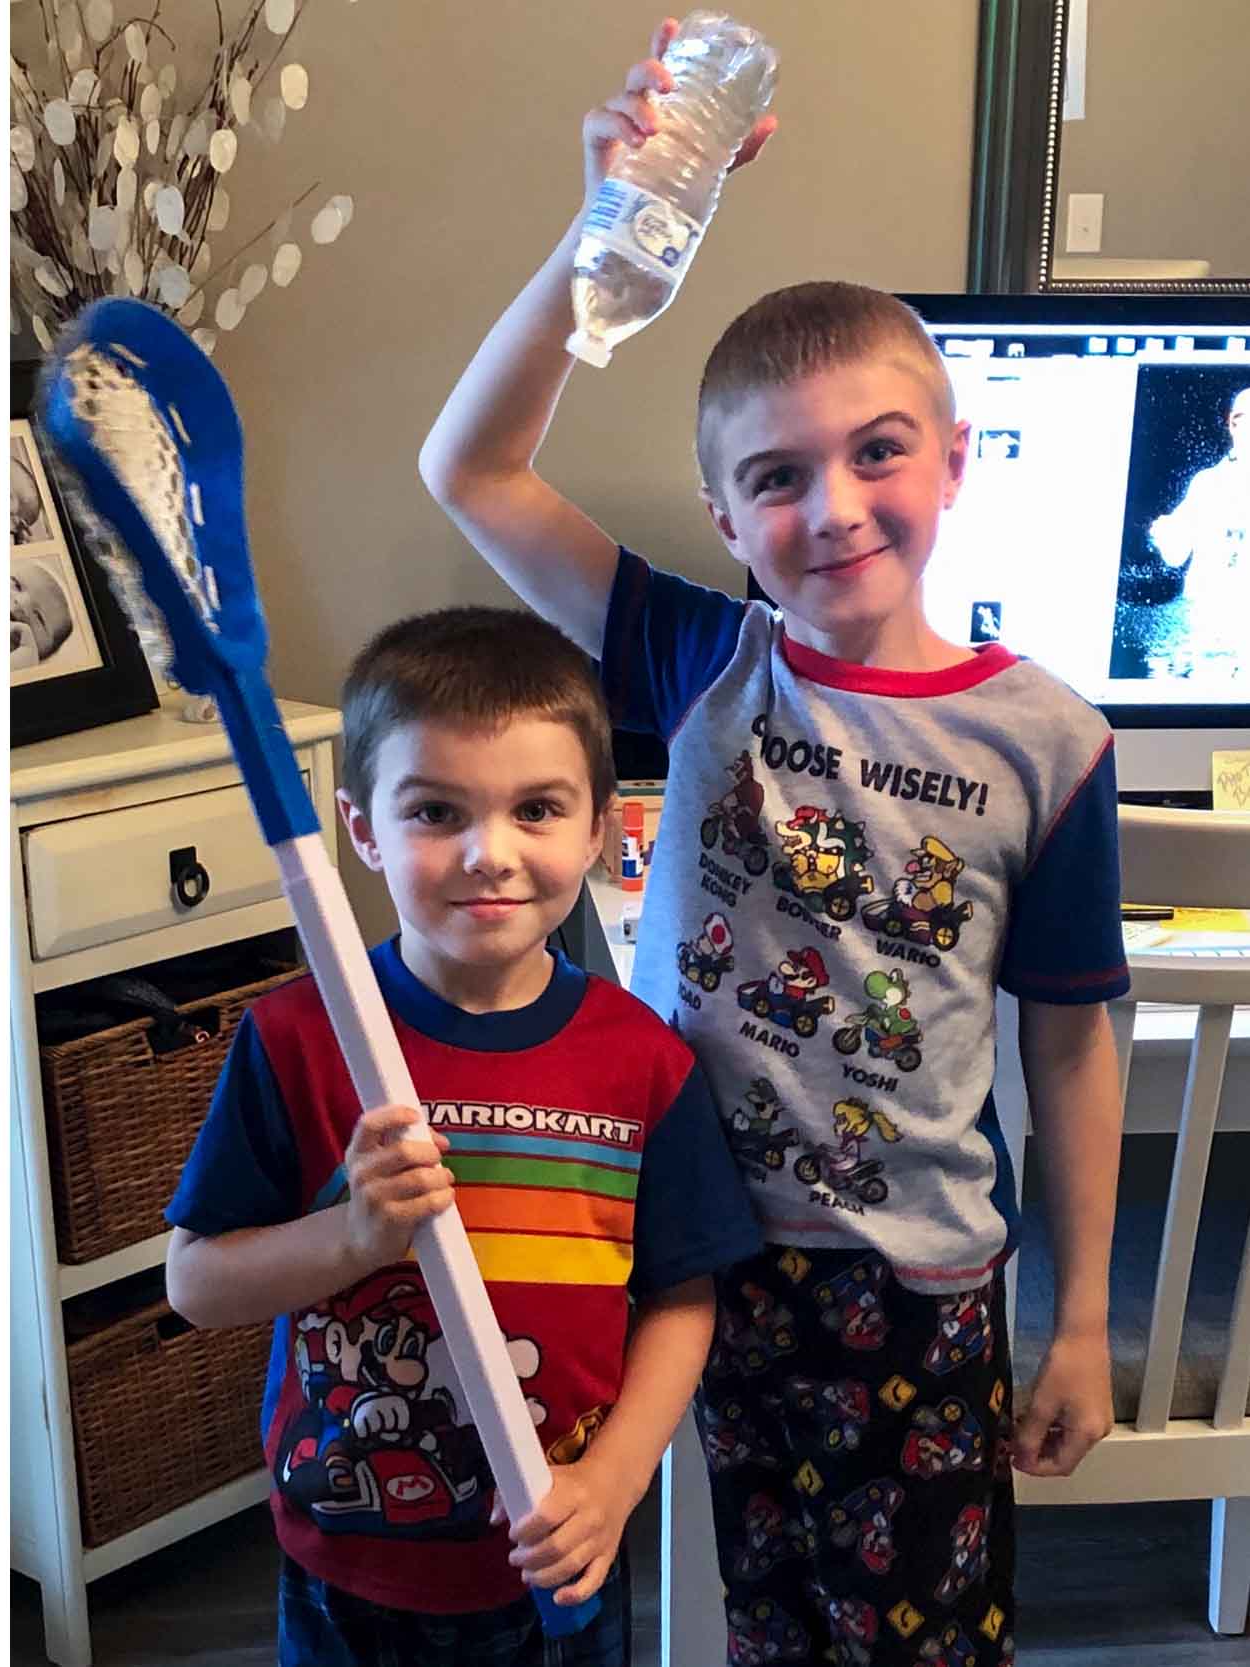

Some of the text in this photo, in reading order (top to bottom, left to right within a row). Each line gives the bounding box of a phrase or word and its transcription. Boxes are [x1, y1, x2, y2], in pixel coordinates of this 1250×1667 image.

[751, 713, 988, 816] COOSE WISELY!
[699, 852, 752, 894] DONKEY
[701, 873, 737, 907] KONG
[776, 896, 842, 941] BOWER
[876, 939, 941, 968] WARIO
[678, 980, 702, 1010] OAD
[740, 1021, 800, 1057] MARIO
[842, 1063, 899, 1092] YOSHI
